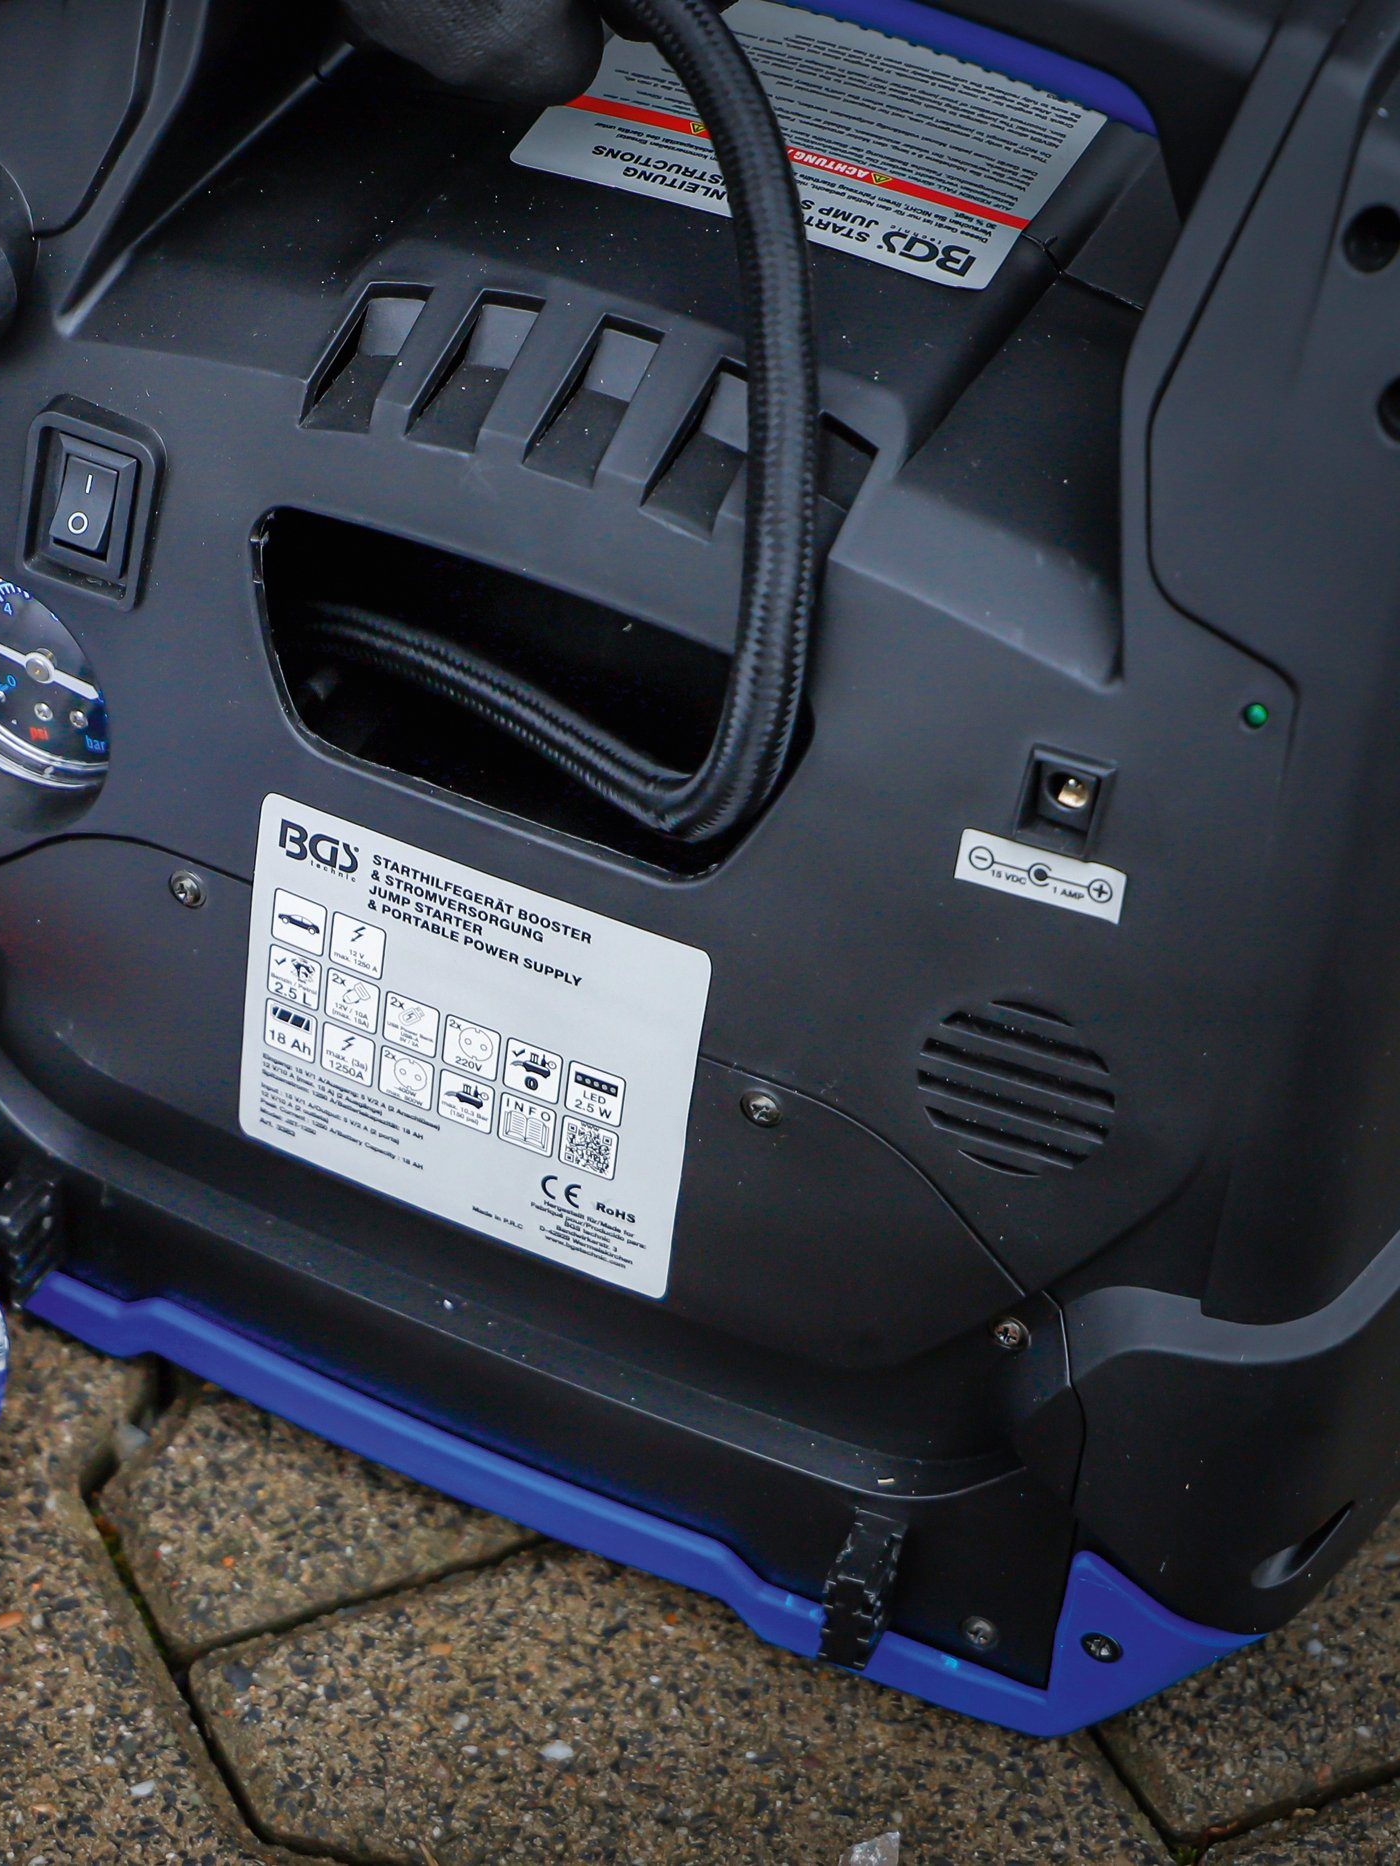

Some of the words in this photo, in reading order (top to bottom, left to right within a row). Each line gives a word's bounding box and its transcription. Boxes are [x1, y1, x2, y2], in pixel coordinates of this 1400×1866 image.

[790, 150, 872, 178] ACHTUNG
[620, 165, 727, 201] NLEITUNG
[815, 204, 881, 229] JUMP
[877, 232, 976, 277] BGS
[86, 735, 106, 752] bar
[278, 818, 359, 874] BGS
[310, 860, 356, 883] technic
[1005, 872, 1026, 885] VDC
[371, 869, 380, 882] &
[385, 874, 544, 942] STROMVERSORGUNG
[372, 853, 514, 916] STARTHILFEGERÄT
[518, 908, 591, 944] BOOSTER
[1060, 889, 1084, 900] AMP
[369, 884, 410, 908] JUMP
[414, 901, 482, 936] STARTER
[348, 948, 356, 957] 12
[368, 899, 376, 911] &
[382, 904, 459, 942] PORTABLE
[463, 934, 519, 964] POWER
[522, 956, 582, 987] SUPPLY
[331, 972, 346, 986] 2x
[274, 981, 297, 1000] 2.5
[302, 993, 311, 1006] L
[389, 995, 404, 1010] 2x
[449, 1019, 461, 1031] 2x
[269, 1028, 286, 1045] 18
[291, 1037, 311, 1056] Ah
[325, 1048, 348, 1063] max.
[383, 1048, 396, 1060] 2x
[454, 1055, 482, 1072] 220V
[328, 1059, 364, 1080] 1250A
[582, 1089, 605, 1105] LED
[506, 1097, 550, 1122] INFO
[574, 1098, 594, 1114] 2.5
[598, 1107, 611, 1120] W
[595, 1200, 635, 1225] RoHS
